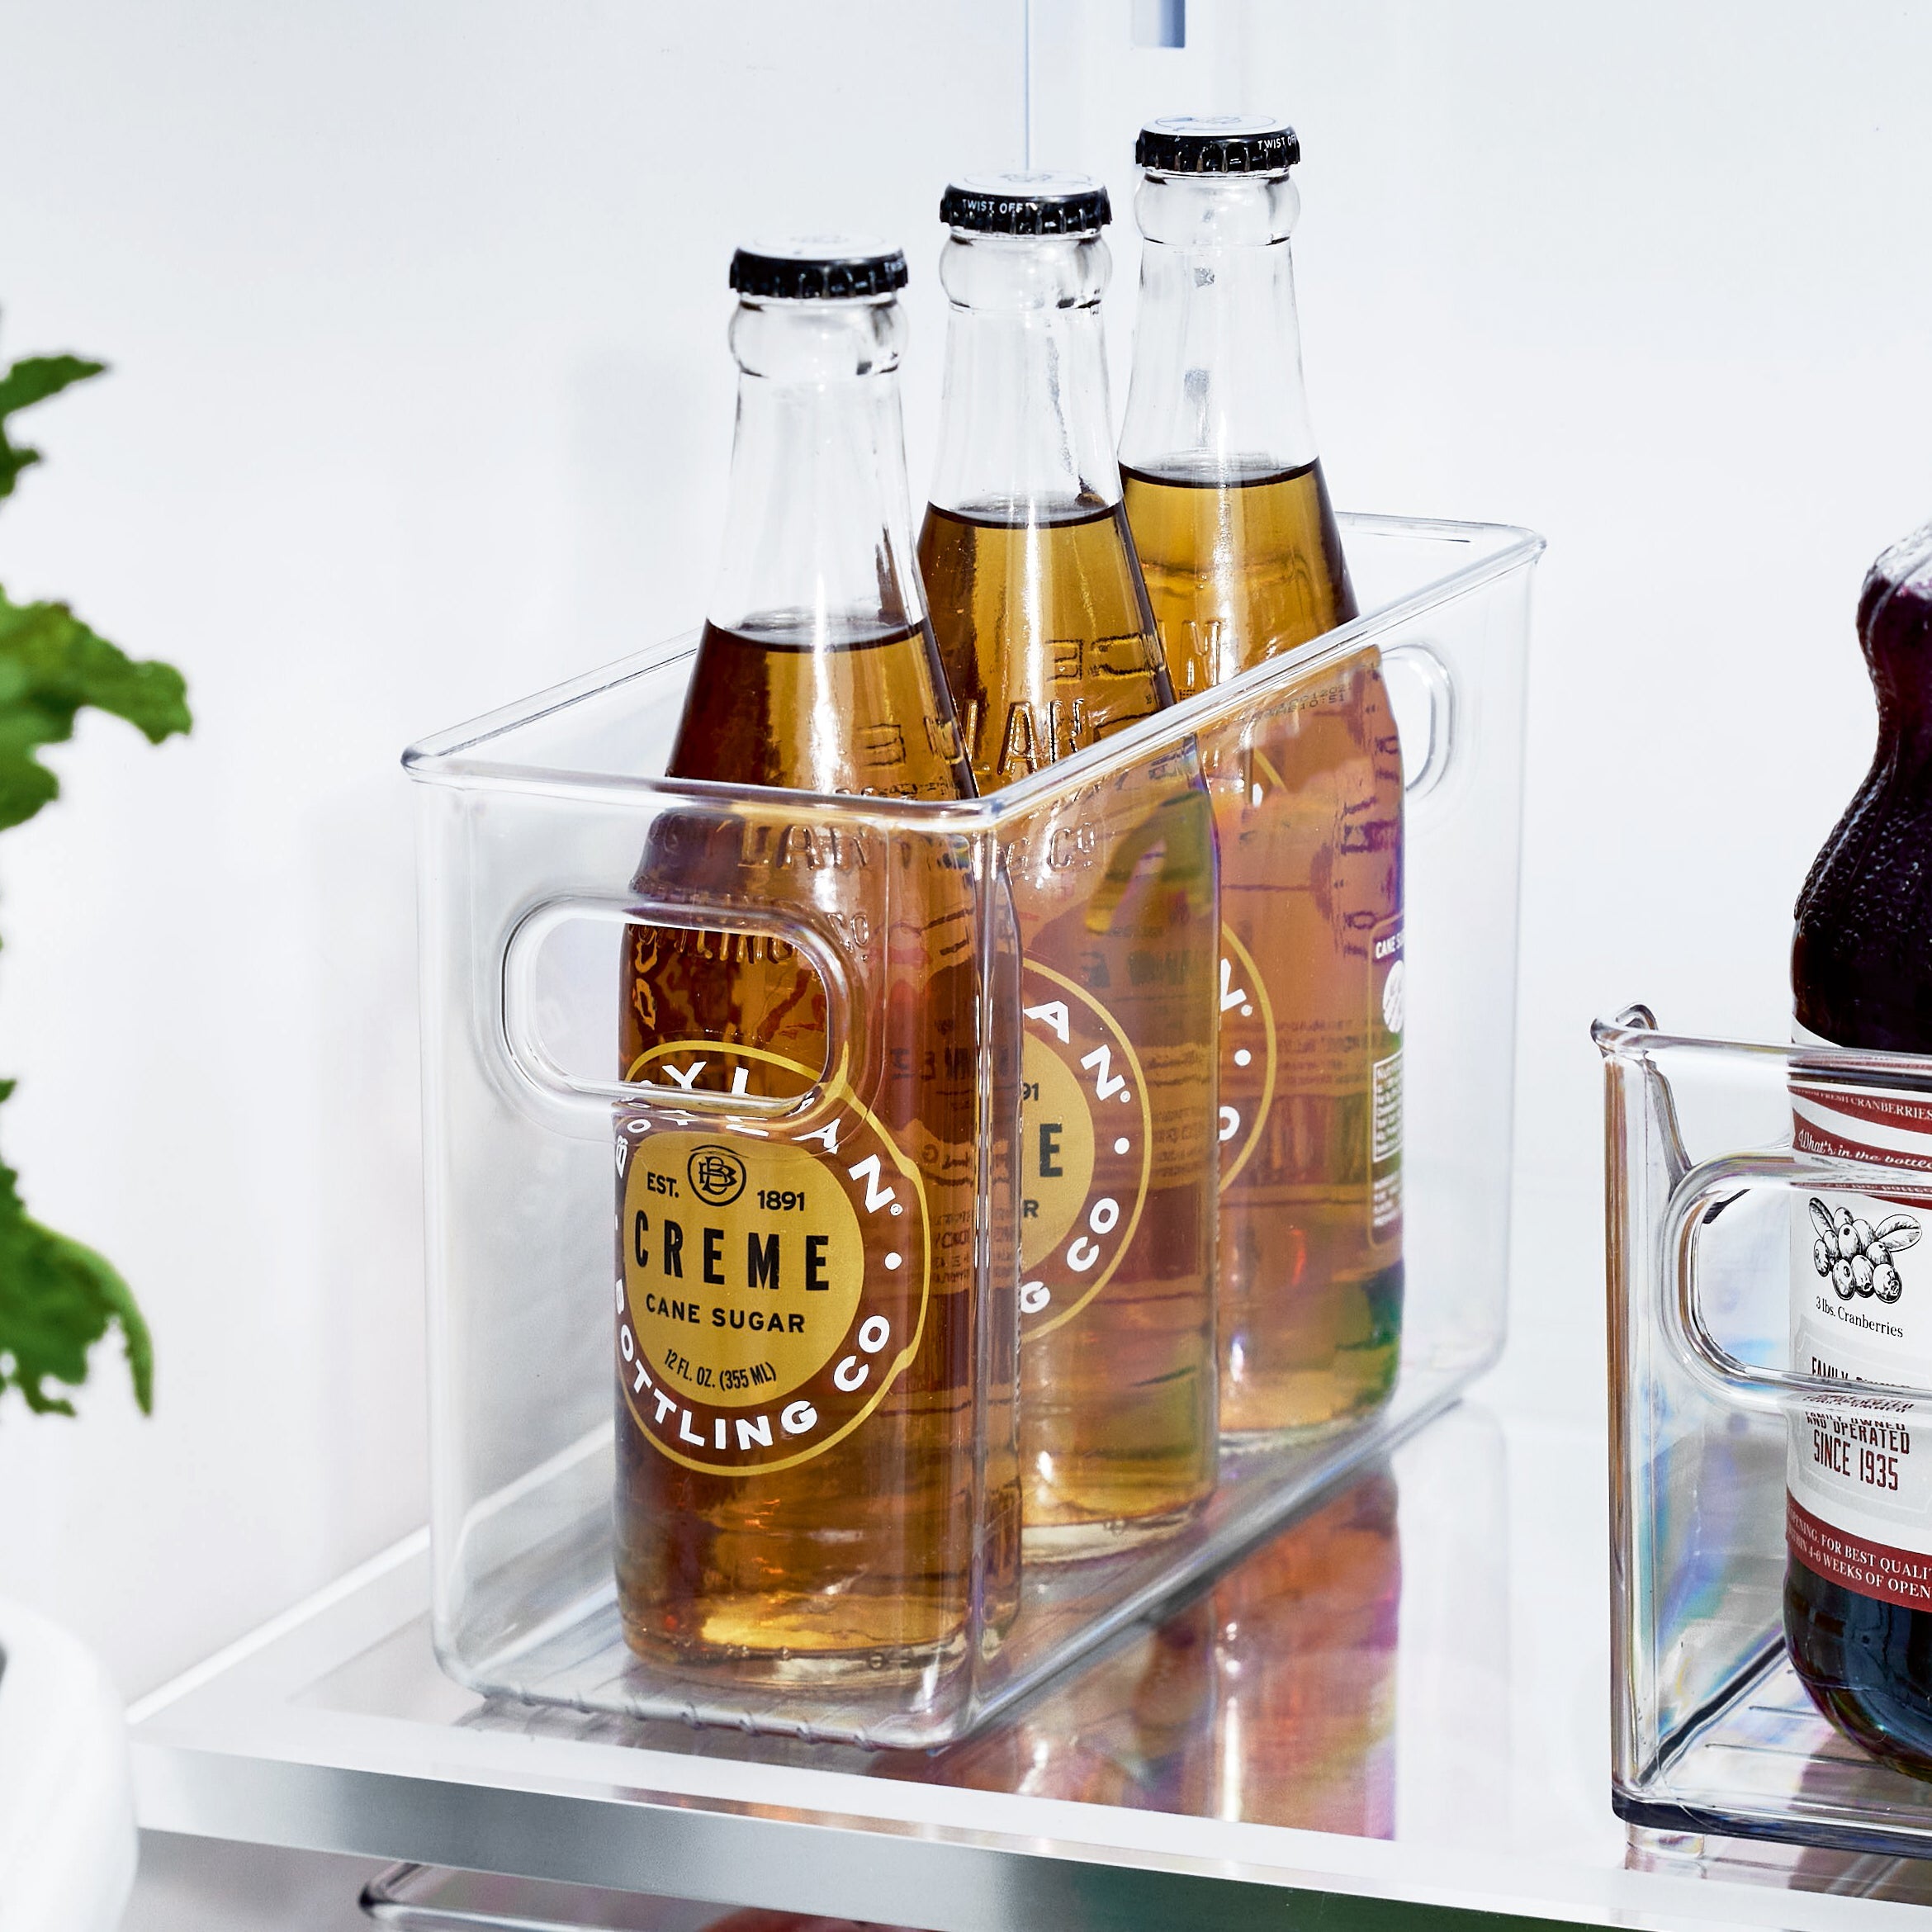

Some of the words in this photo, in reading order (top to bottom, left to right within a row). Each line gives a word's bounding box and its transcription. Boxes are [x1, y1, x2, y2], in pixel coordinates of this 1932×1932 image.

[1257, 136, 1285, 150] TWIST
[962, 199, 995, 211] TWIST
[999, 202, 1023, 214] OFF
[1821, 1092, 1849, 1104] FRESH
[1850, 1098, 1932, 1120] CRANBERRIES
[1798, 1129, 1837, 1155] What's
[1838, 1144, 1852, 1157] in
[1855, 1151, 1881, 1162] the
[647, 1172, 679, 1198] EST.
[757, 1190, 805, 1211] 1891
[635, 1210, 829, 1291] CREME
[646, 1293, 700, 1324] CANE
[712, 1308, 805, 1333] SUGAR
[1816, 1295, 1821, 1310] 3
[1822, 1298, 1836, 1317] lbs.
[1838, 1306, 1903, 1338] Cranberries
[664, 1348, 677, 1369] 12
[677, 1361, 693, 1382] FL.
[697, 1369, 715, 1388] OZ.
[719, 1368, 749, 1391] (355
[752, 1361, 776, 1386] ML)
[833, 1315, 890, 1392] CO
[1834, 1421, 1910, 1455] OPERATED
[1814, 1429, 1850, 1476] SINCE
[1860, 1448, 1898, 1490] 1935
[1821, 1534, 1841, 1555] FOR
[1845, 1546, 1876, 1567] BEST
[1880, 1558, 1932, 1579] QUALI
[1824, 1553, 1862, 1580] WEEKS
[1866, 1572, 1884, 1587] OF
[1888, 1579, 1931, 1598] OPEN
